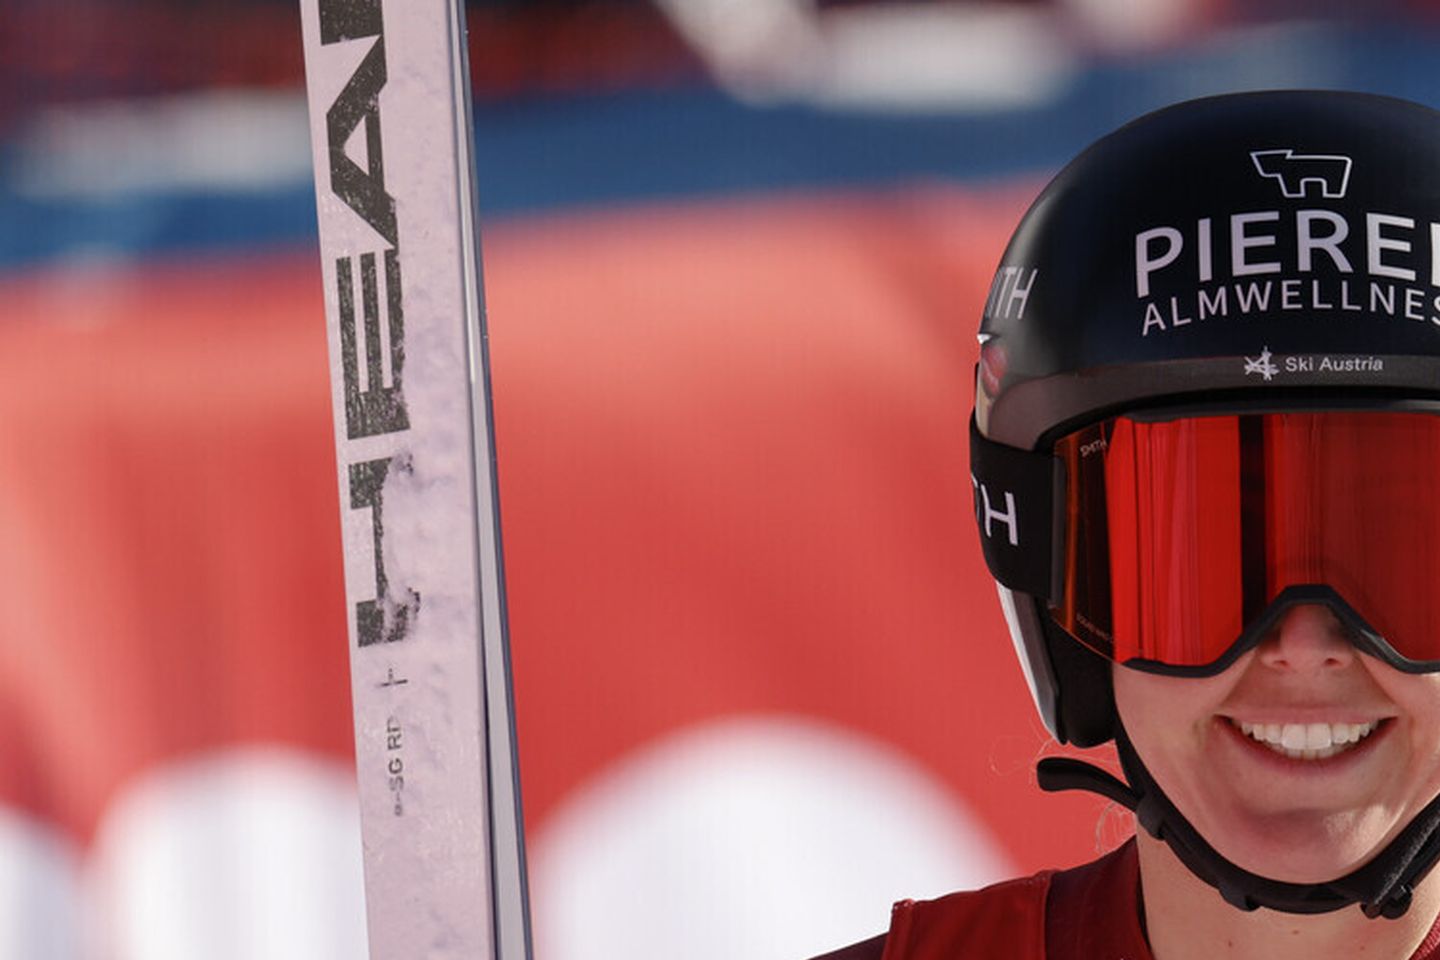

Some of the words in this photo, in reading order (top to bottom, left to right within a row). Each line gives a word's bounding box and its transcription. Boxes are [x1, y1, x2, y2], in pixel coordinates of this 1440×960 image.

[318, 0, 420, 647] HEA
[1285, 357, 1313, 372] Ski
[1319, 356, 1384, 371] Austria
